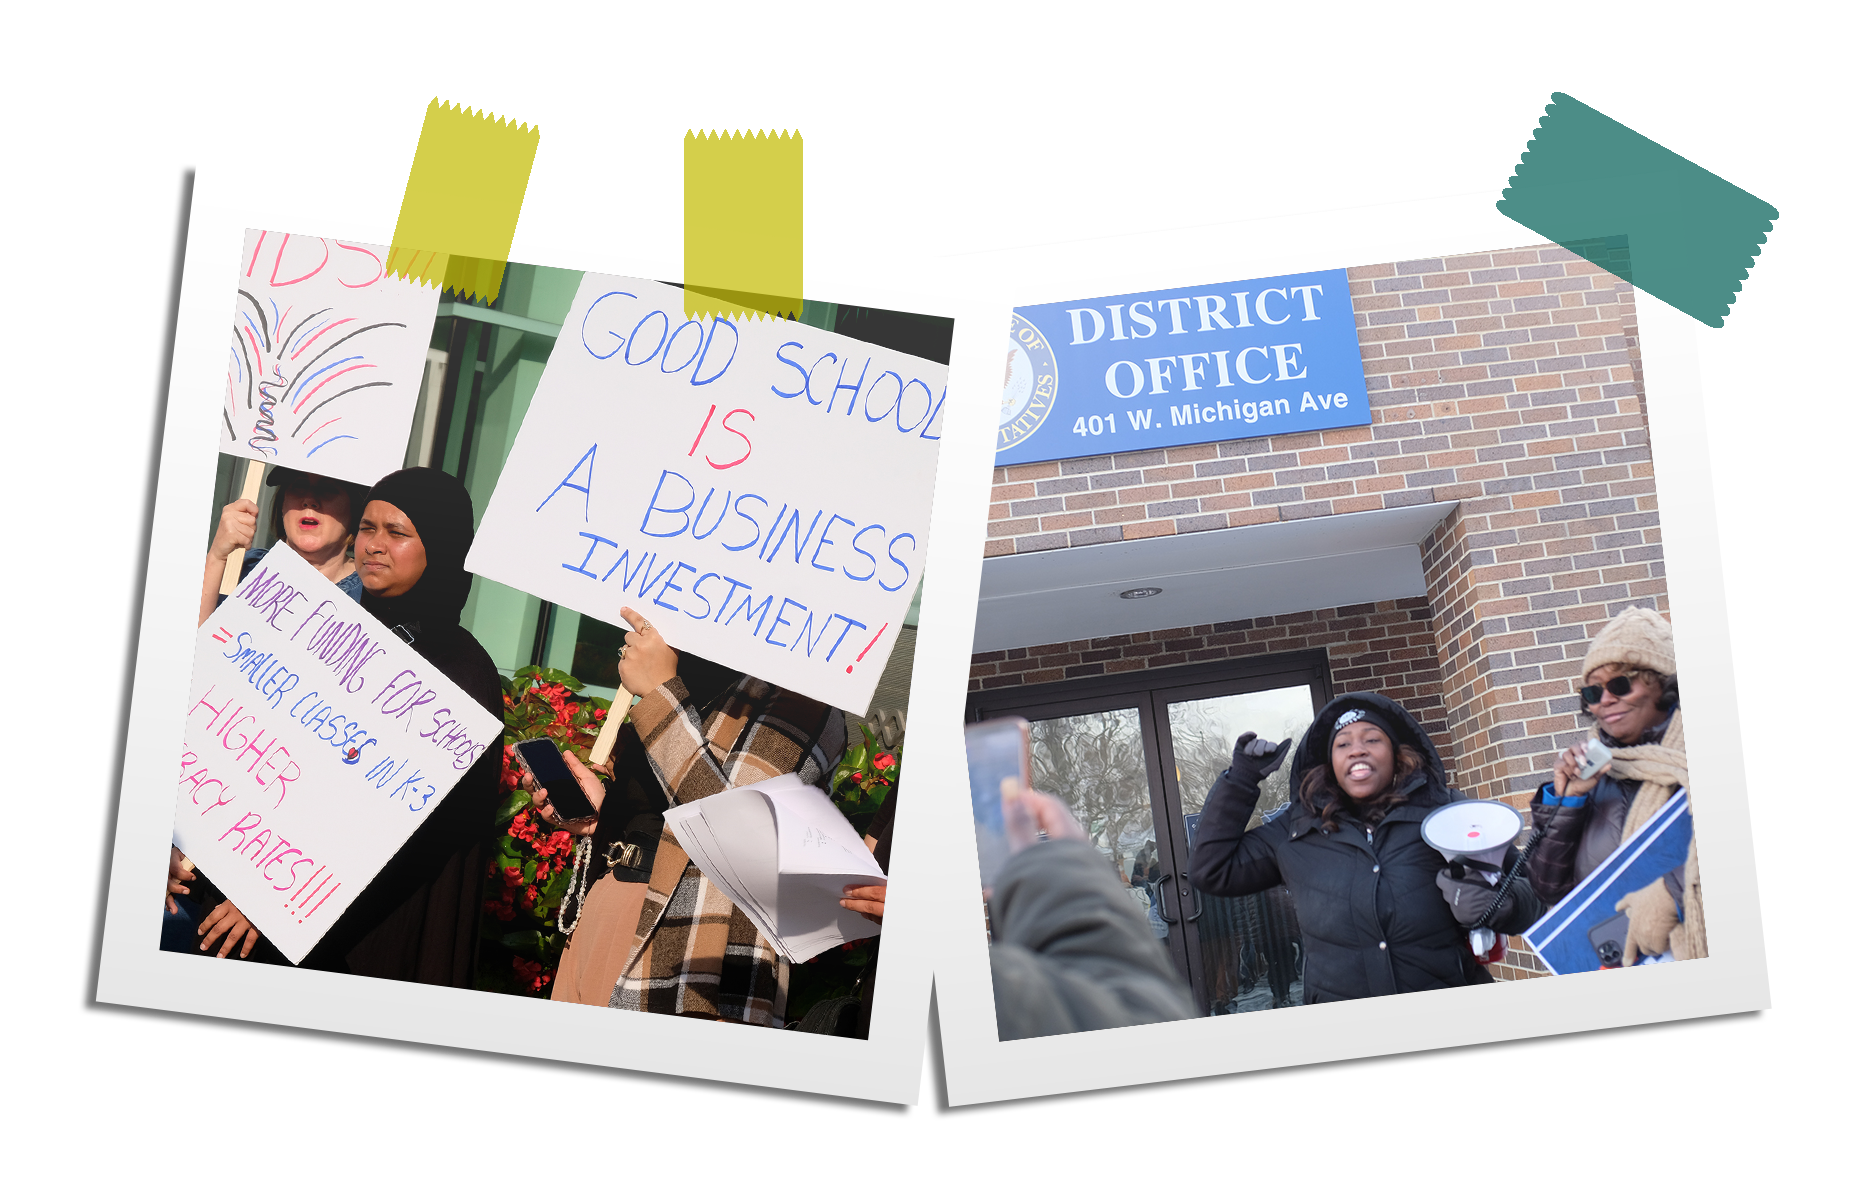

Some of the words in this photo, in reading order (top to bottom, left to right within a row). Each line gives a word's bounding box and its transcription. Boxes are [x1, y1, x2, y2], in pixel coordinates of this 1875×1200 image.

[581, 291, 739, 387] GOOD
[771, 341, 947, 441] SCHOOL
[1018, 327, 1045, 351] OF
[1065, 284, 1324, 346] DISTRICT
[1104, 342, 1309, 399] OFFICE
[687, 403, 756, 471] IS
[1072, 413, 1116, 438] 401
[1126, 408, 1162, 432] W.
[1170, 397, 1291, 427] Michigan
[1299, 391, 1349, 413] Ave
[536, 443, 598, 523] A
[639, 469, 917, 593] BUSINESS
[561, 531, 889, 675] INVESTMENT!
[222, 631, 301, 710] SMALLER
[364, 755, 409, 790] IN
[389, 769, 436, 812] K-3
[236, 566, 309, 632] MORE
[290, 600, 387, 694] FUNDING
[371, 669, 437, 733] FOR
[419, 708, 487, 770] SCHOOLS
[187, 684, 302, 810] HIGHER
[217, 811, 342, 924] RATES!!!
